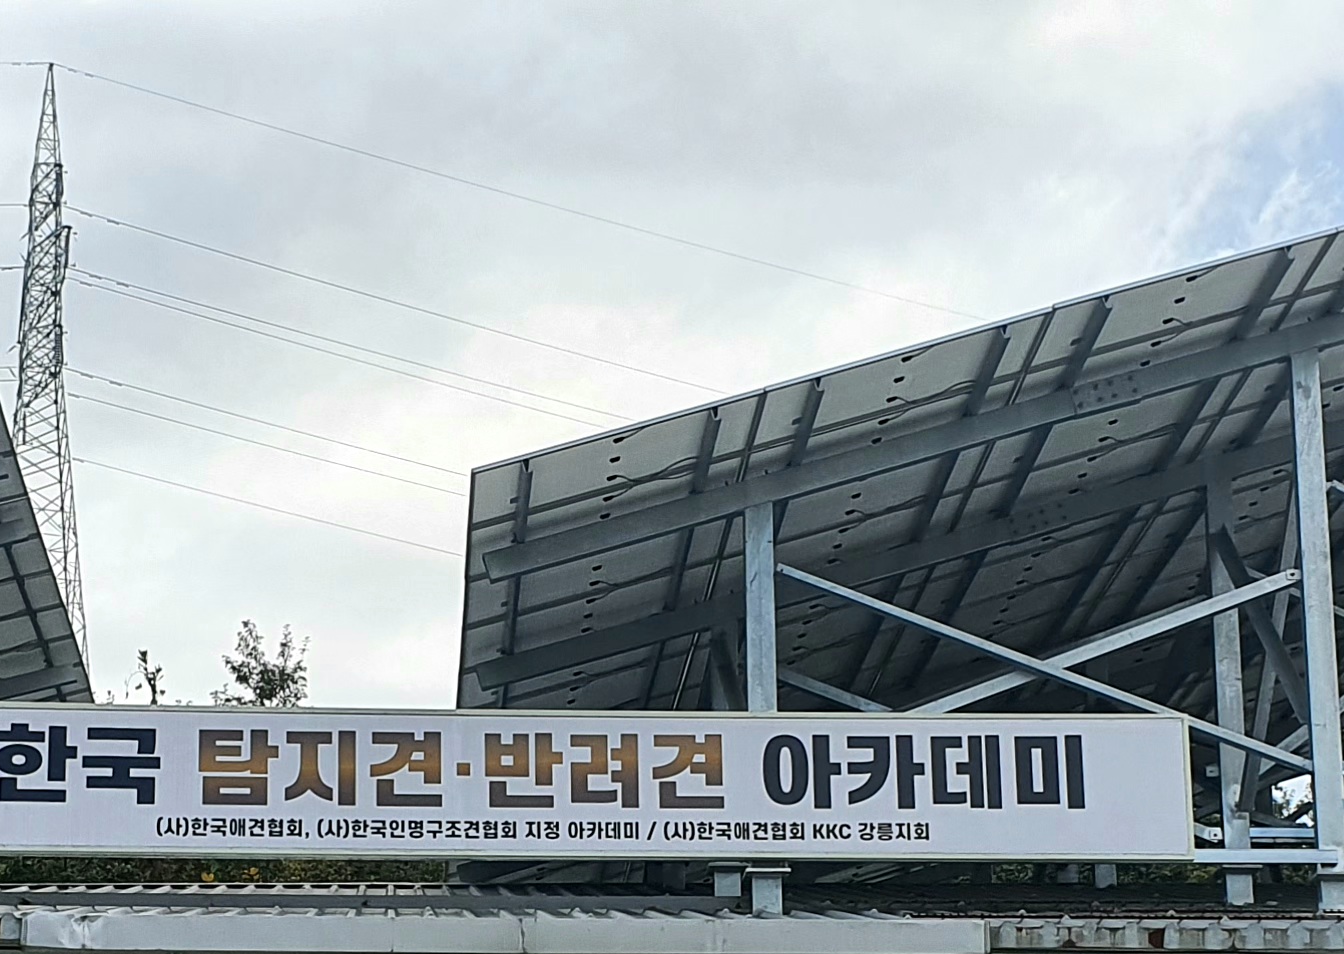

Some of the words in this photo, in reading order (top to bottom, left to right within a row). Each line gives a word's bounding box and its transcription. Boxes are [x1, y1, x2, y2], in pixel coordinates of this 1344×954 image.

[198, 729, 726, 809] 탐지견·반려견
[762, 733, 1087, 810] 아카데미
[156, 816, 311, 840] (사)한국애견협회,
[316, 818, 517, 840] (사)한국인명구조견협회
[524, 820, 561, 840] 지정
[567, 820, 640, 841] 아카데미
[663, 820, 806, 842] (사)한국애견협회
[812, 822, 853, 840] KKC
[857, 821, 931, 842] 강릉지회
